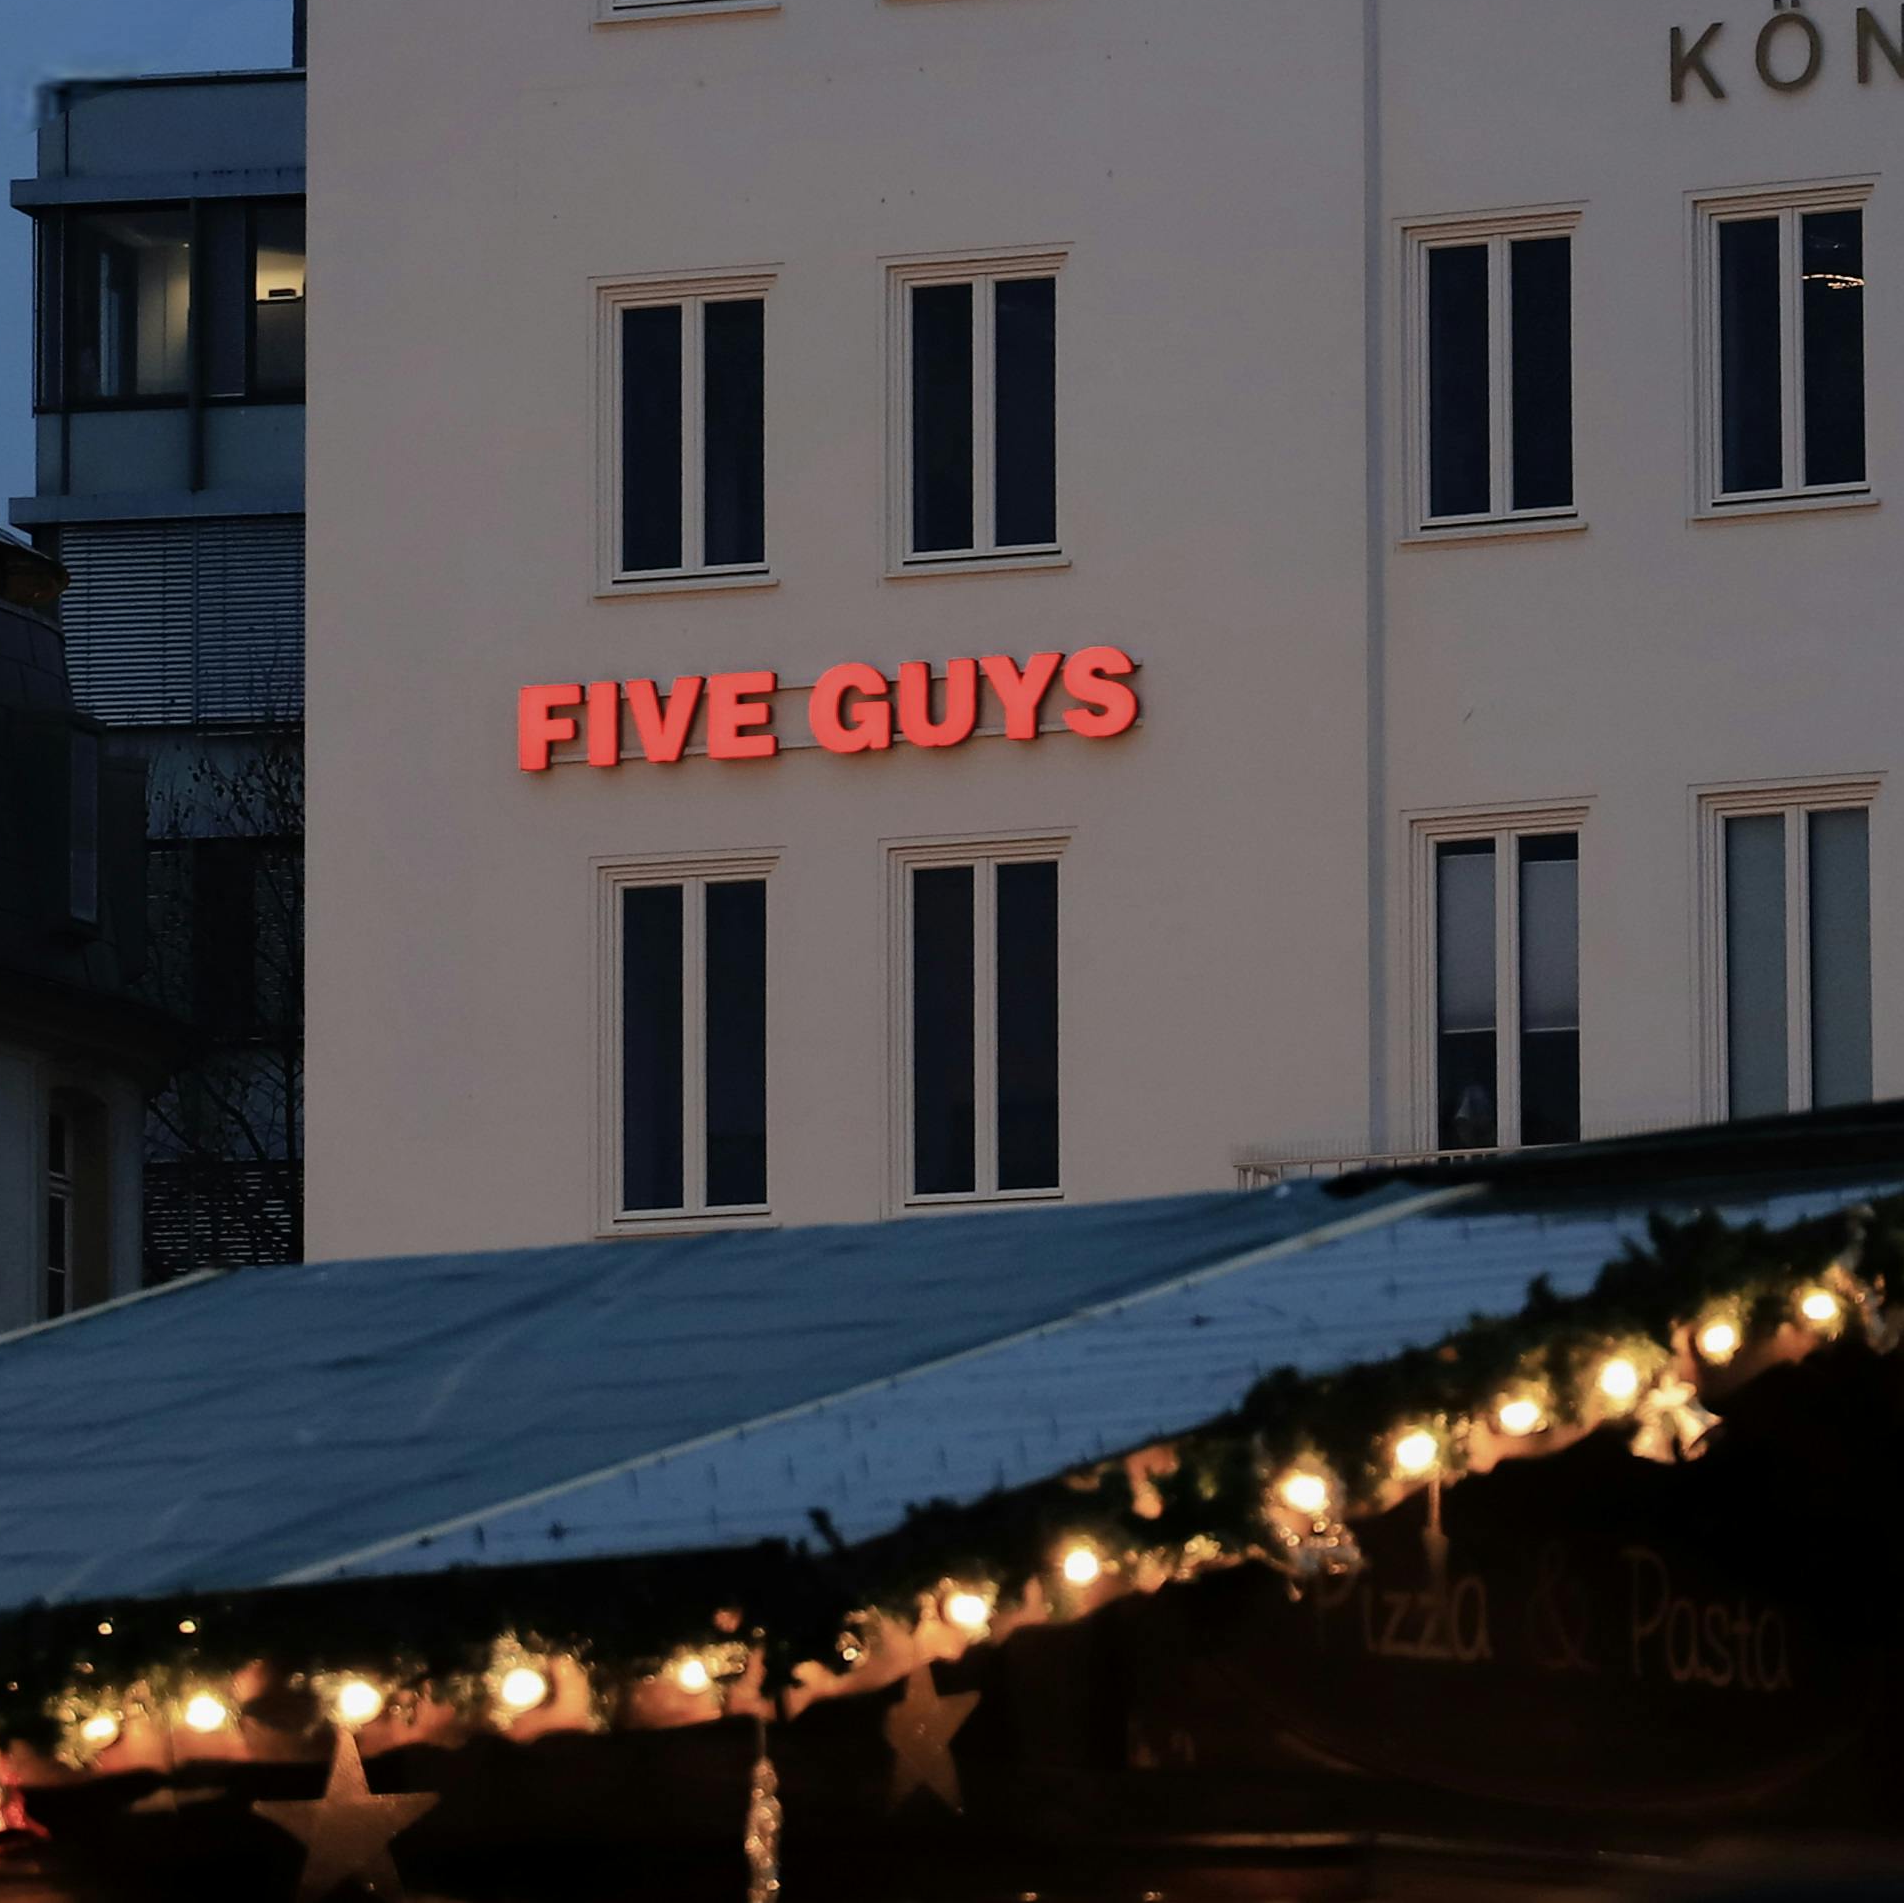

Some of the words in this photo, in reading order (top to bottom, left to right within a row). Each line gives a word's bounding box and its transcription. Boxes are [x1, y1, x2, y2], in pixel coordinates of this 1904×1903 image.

[518, 670, 779, 772] FIVE
[808, 645, 1139, 754] GUYS
[1312, 1572, 1494, 1664] Pizza
[1621, 1545, 1792, 1693] Pasta
